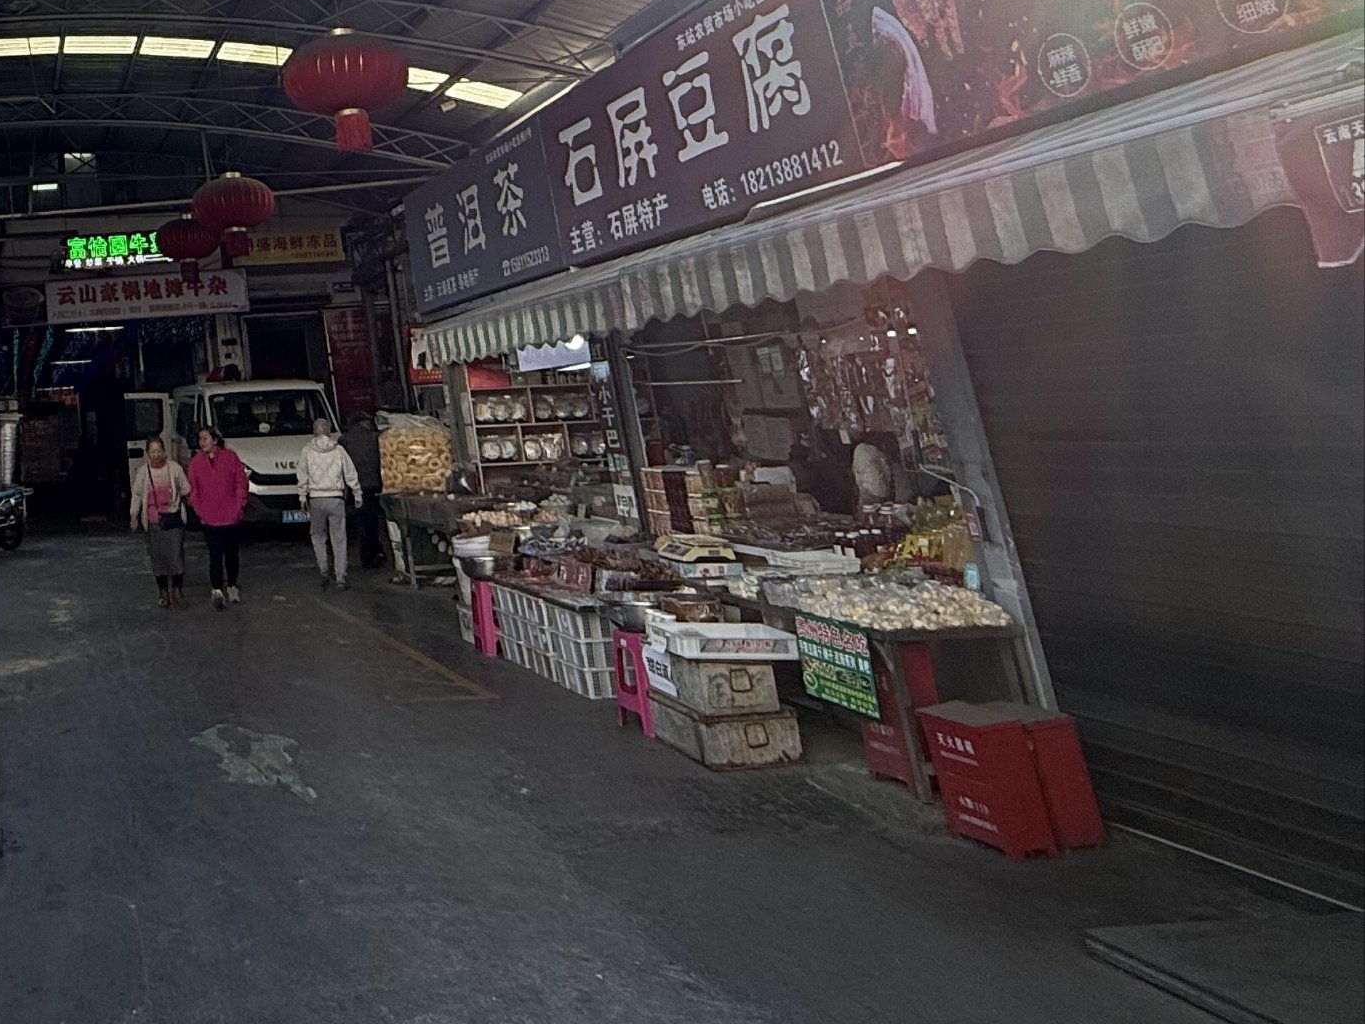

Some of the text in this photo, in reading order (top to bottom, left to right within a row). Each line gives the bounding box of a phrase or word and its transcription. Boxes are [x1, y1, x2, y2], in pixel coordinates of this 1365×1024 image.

[558, 3, 813, 207] 石屏豆腐
[424, 162, 527, 269] 普洱茶
[275, 461, 299, 470] IVE
